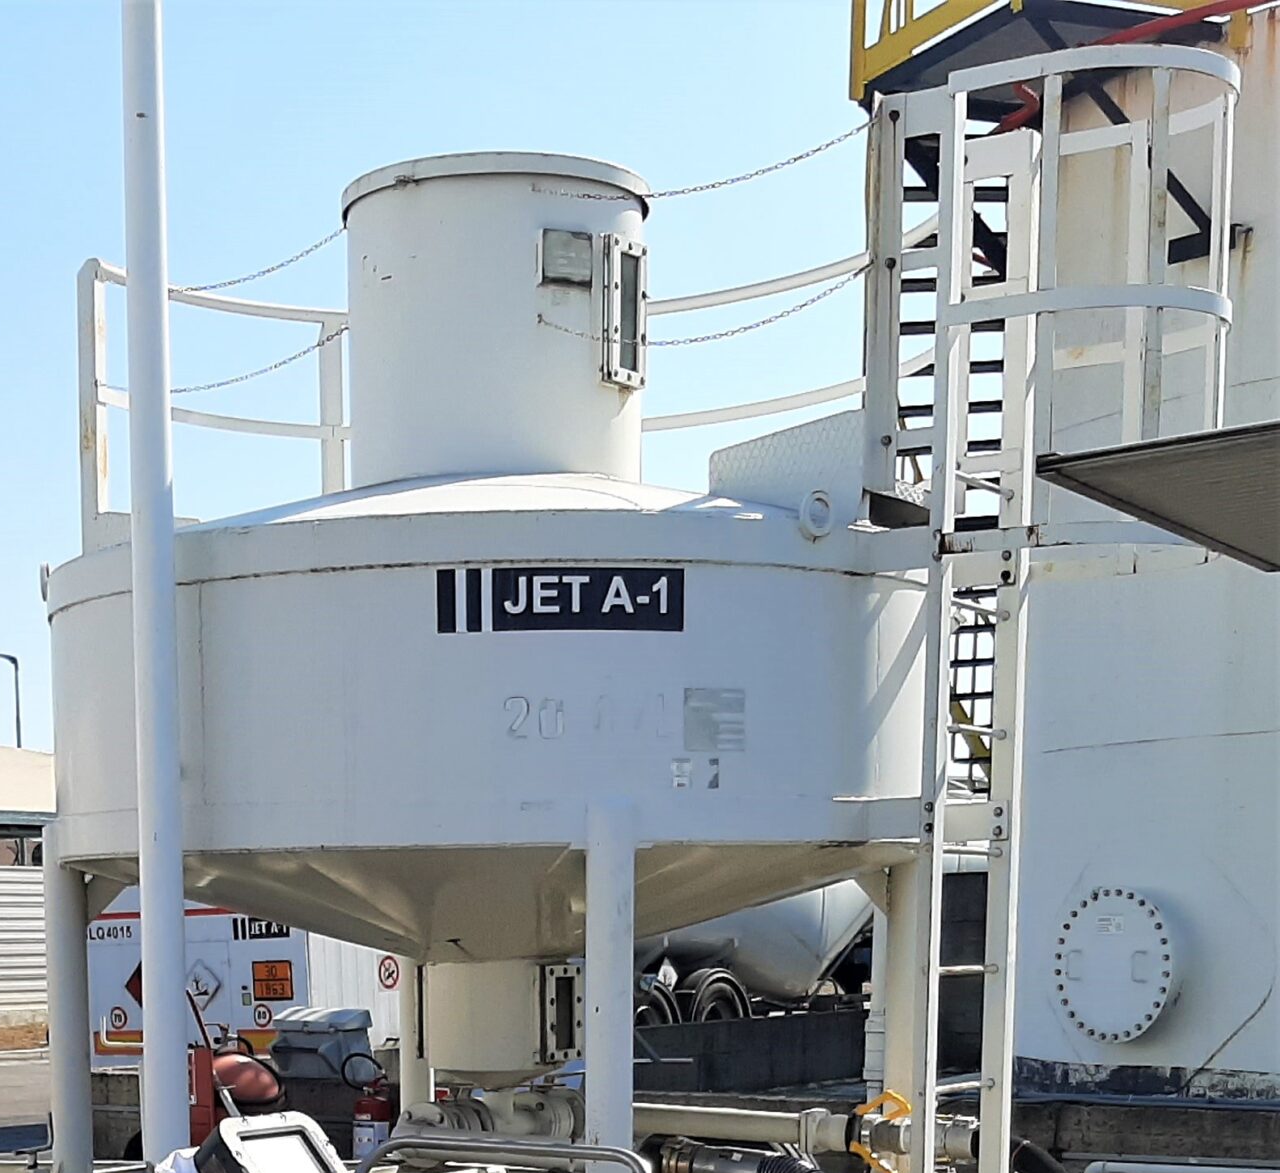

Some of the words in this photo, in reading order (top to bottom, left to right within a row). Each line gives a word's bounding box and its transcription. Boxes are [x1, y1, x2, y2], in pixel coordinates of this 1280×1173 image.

[503, 575, 590, 615] JET
[601, 575, 669, 615] A-1
[250, 920, 268, 935] JET
[264, 965, 278, 978] 30
